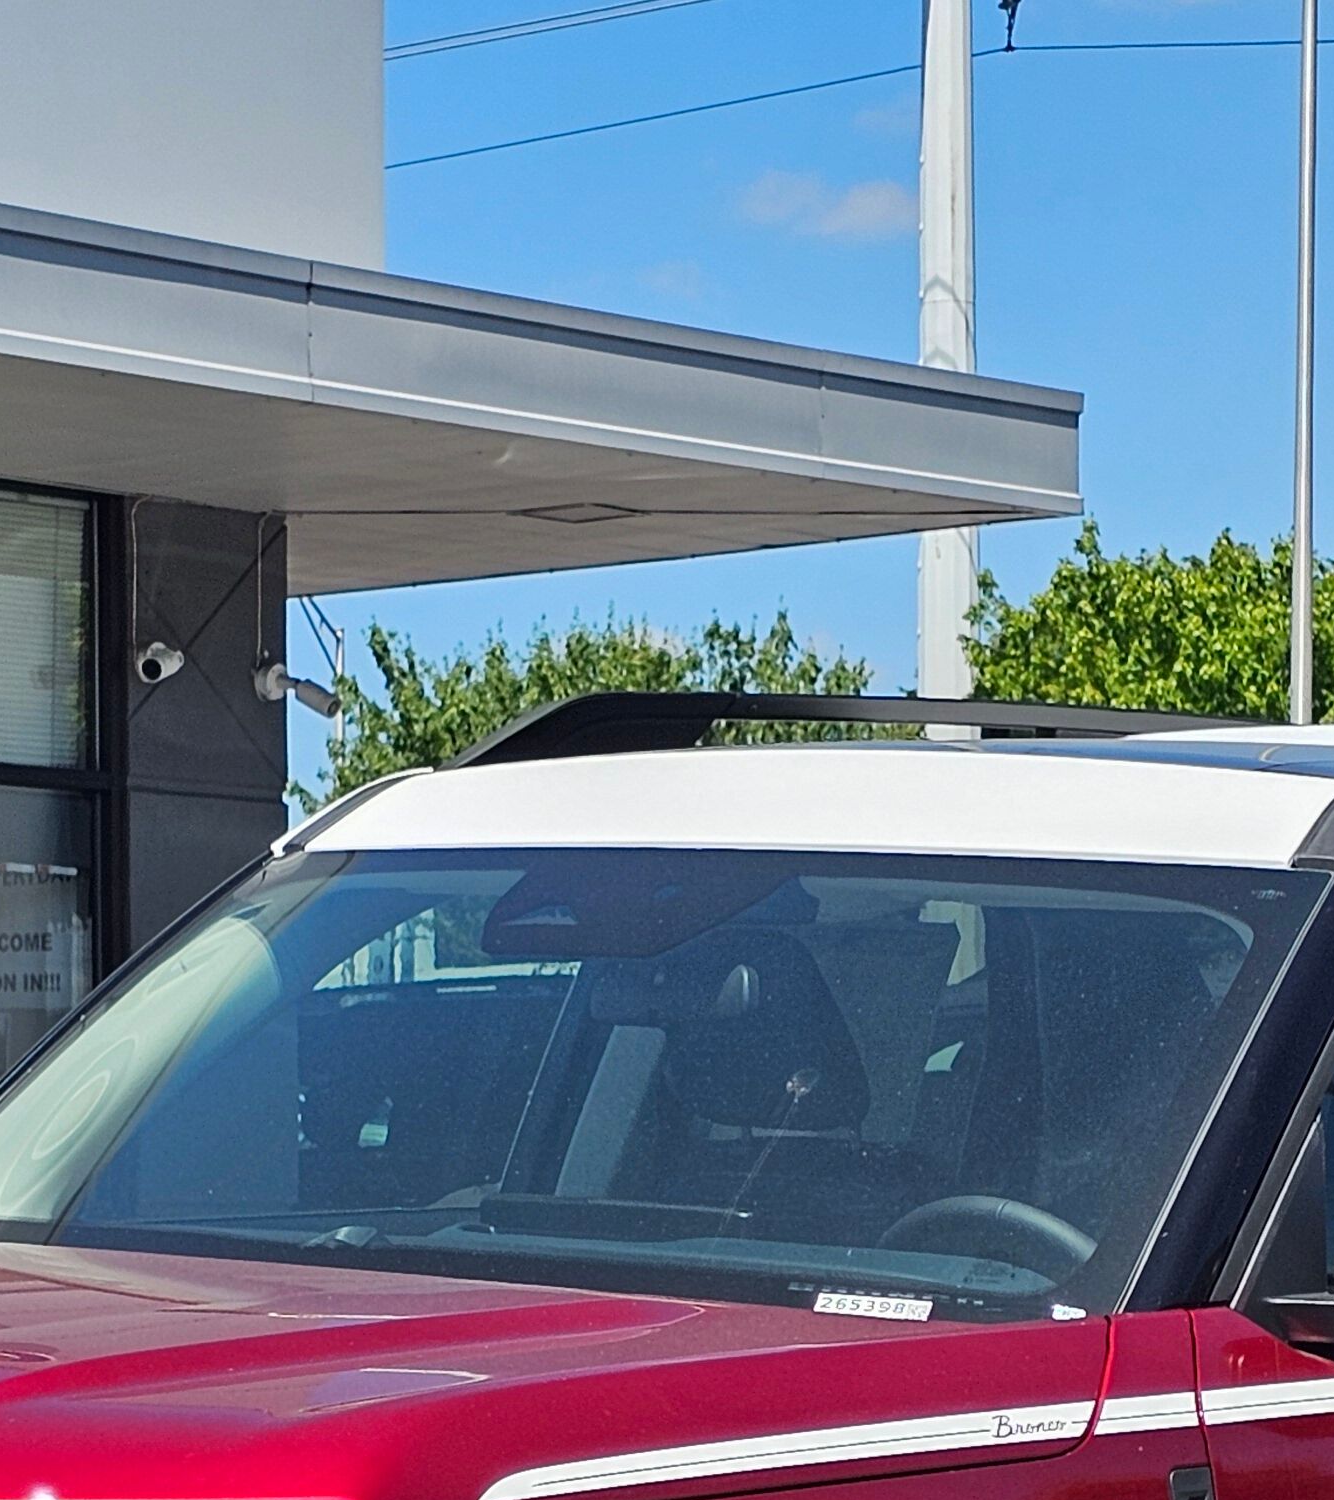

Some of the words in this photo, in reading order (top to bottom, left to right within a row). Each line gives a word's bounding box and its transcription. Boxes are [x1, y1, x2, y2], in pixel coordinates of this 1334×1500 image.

[23, 972, 61, 993] IN!!!
[819, 1296, 906, 1314] 265398
[991, 1414, 1066, 1438] Bronco
